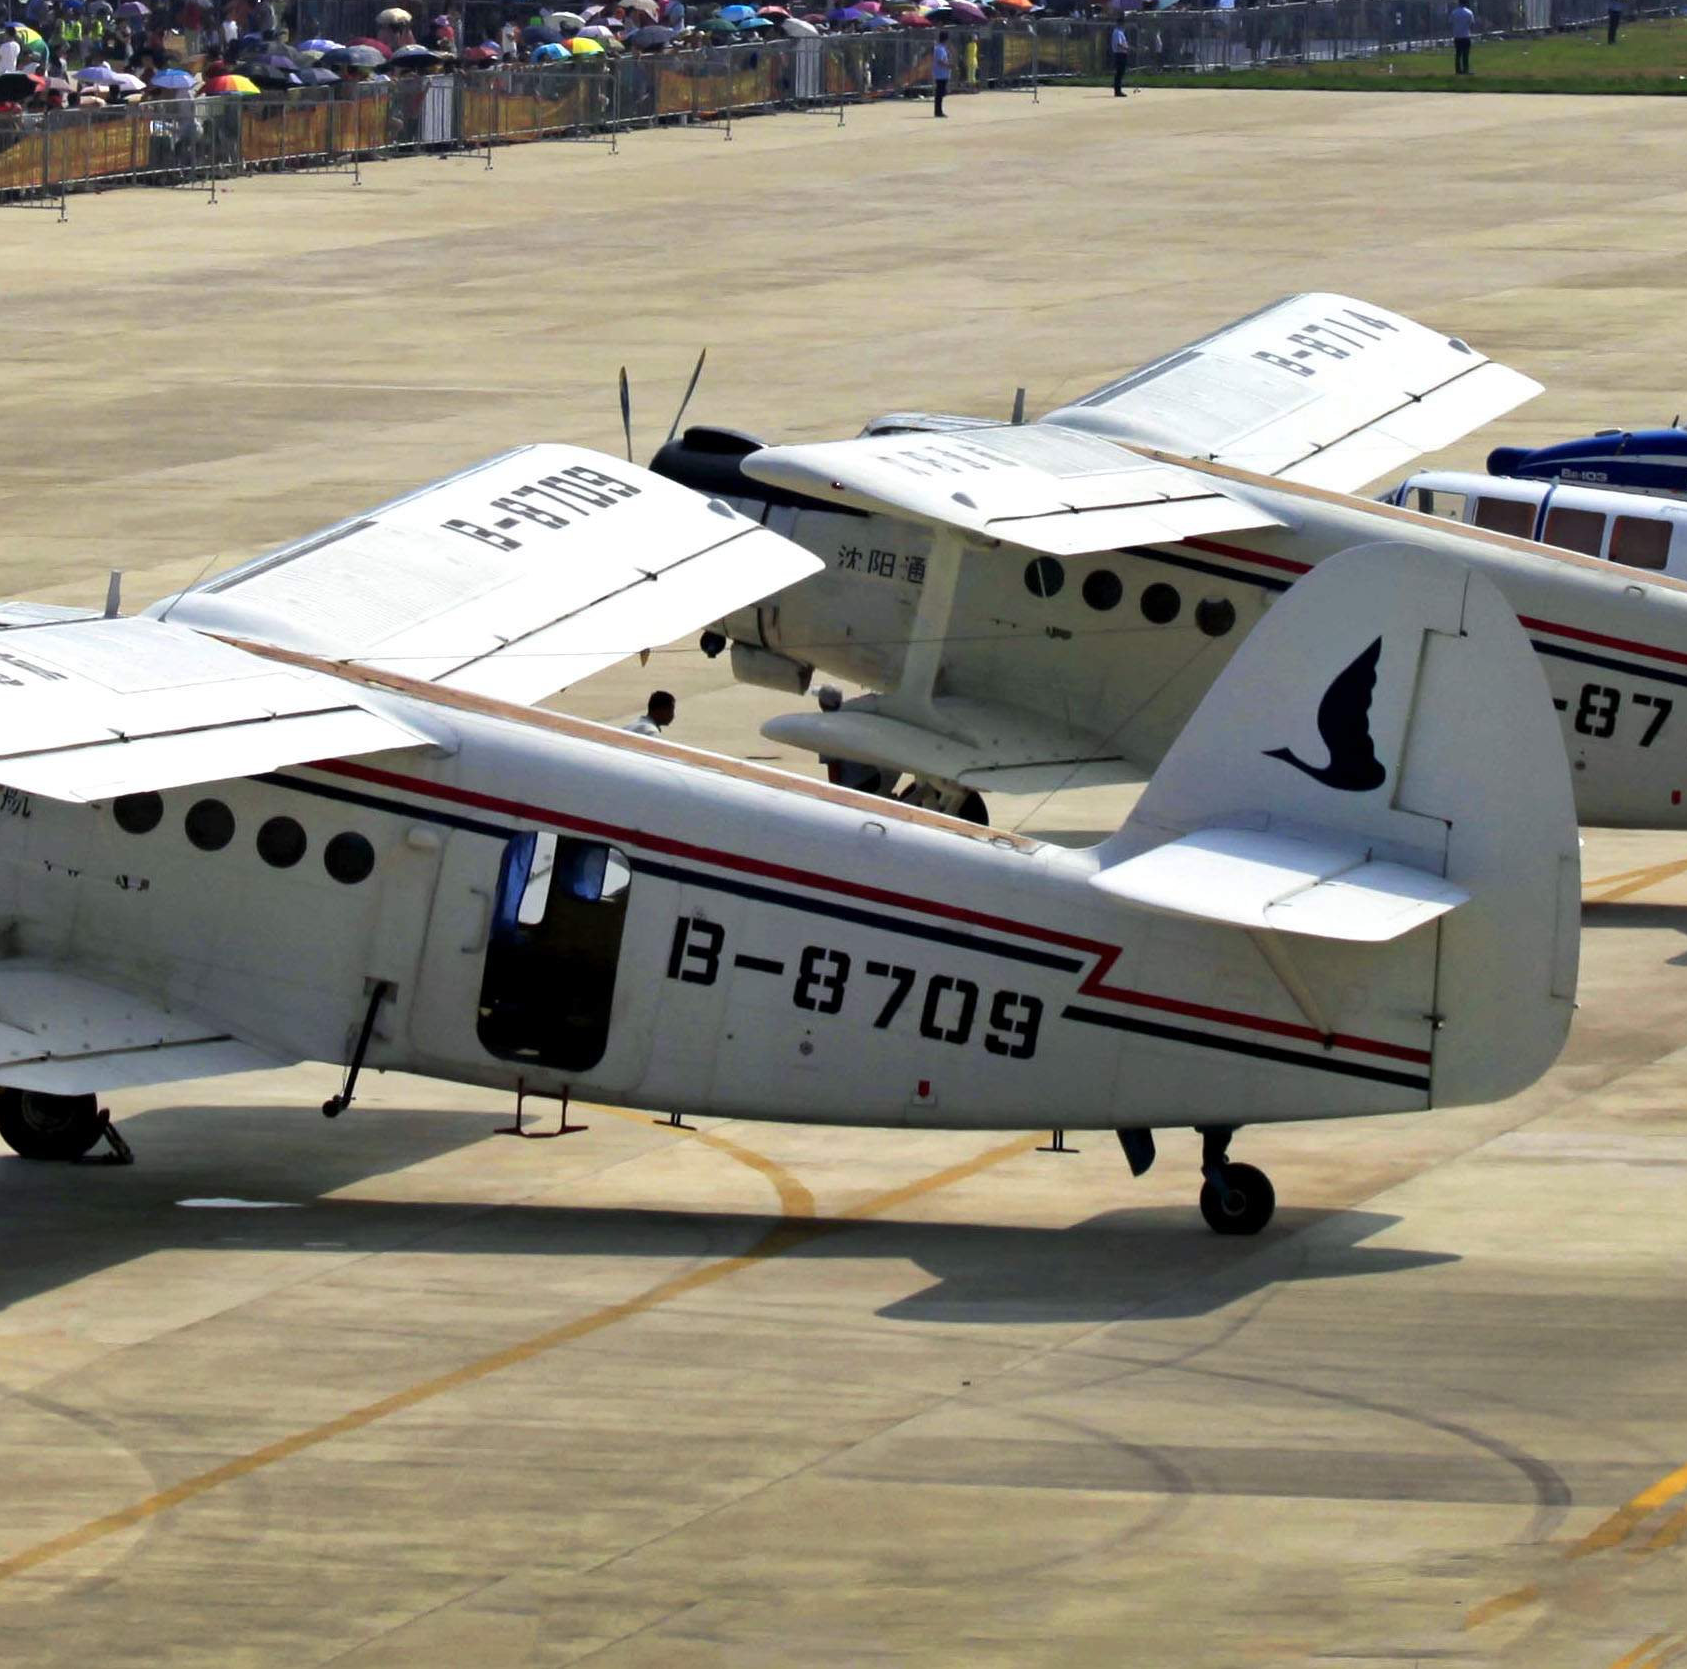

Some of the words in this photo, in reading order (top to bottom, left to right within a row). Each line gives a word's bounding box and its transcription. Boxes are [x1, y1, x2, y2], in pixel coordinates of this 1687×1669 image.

[1251, 309, 1399, 377] B-8714
[440, 466, 642, 551] B-8709
[666, 916, 1044, 1060] B-8709
